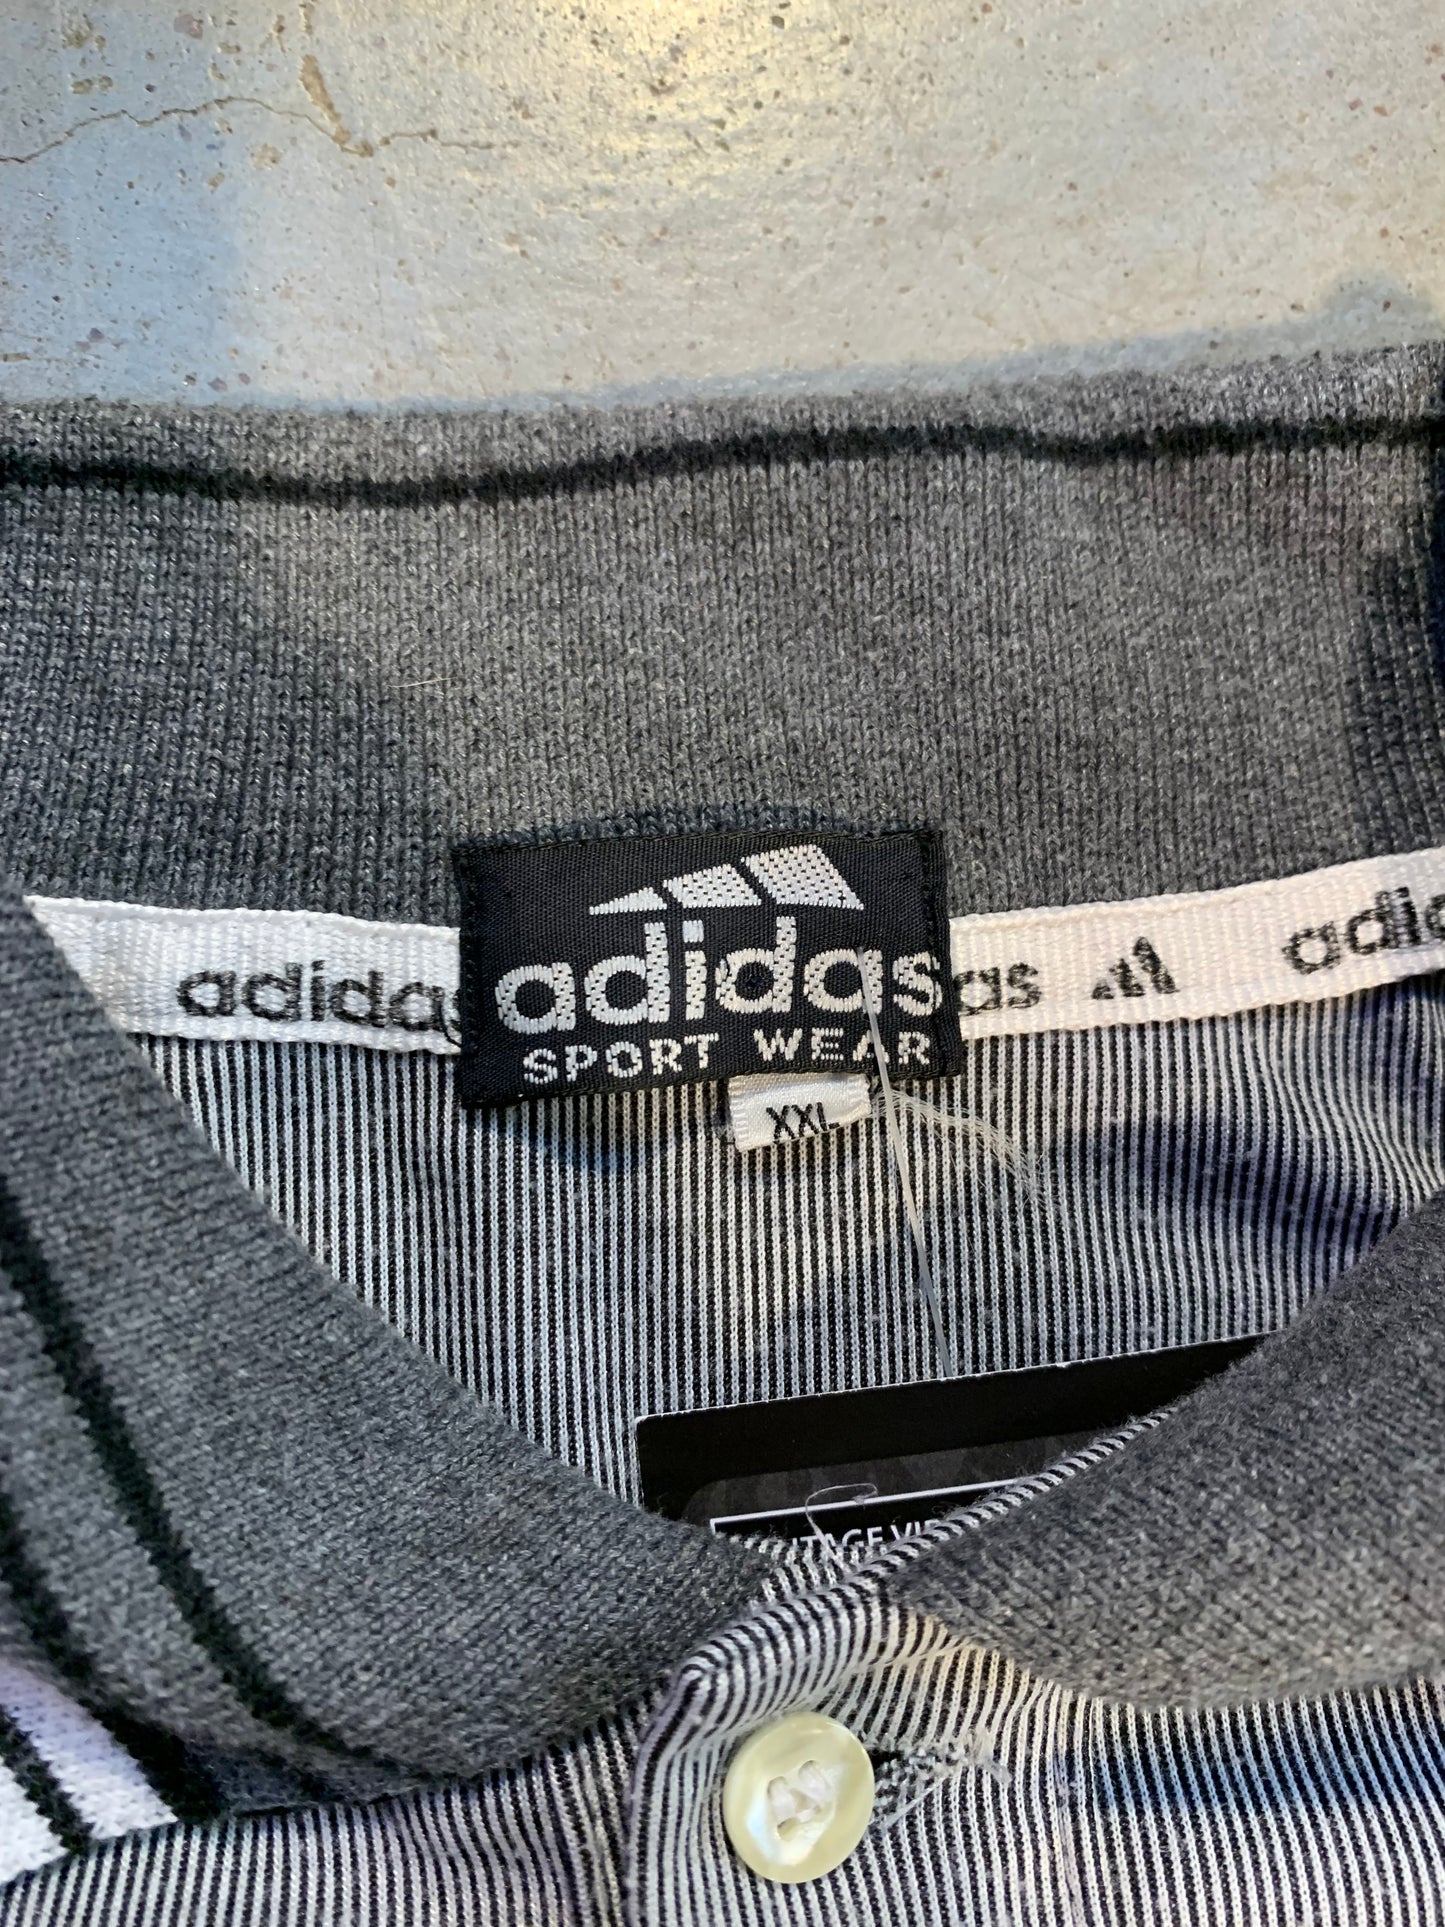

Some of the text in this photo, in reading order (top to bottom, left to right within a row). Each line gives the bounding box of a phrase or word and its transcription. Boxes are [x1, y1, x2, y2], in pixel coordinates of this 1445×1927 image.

[177, 959, 461, 1032] adida
[495, 915, 942, 1035] adidas
[523, 1027, 931, 1084] SPORT WEAR
[766, 1101, 840, 1140] XXL
